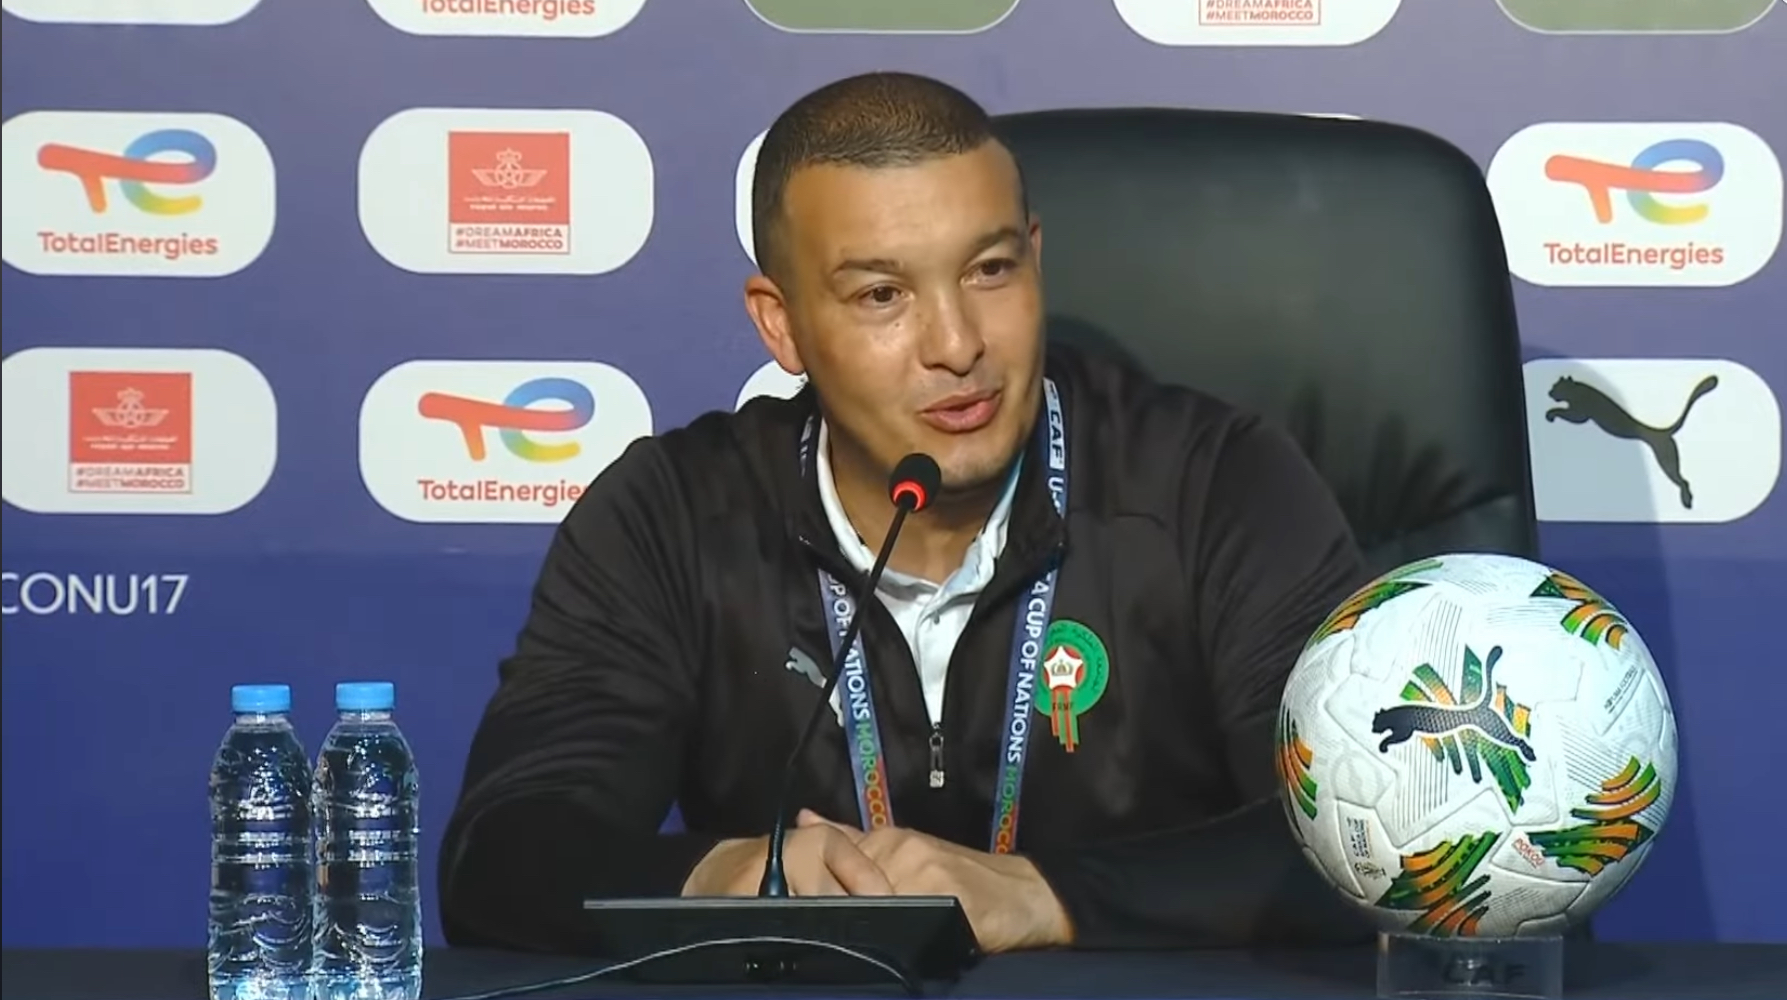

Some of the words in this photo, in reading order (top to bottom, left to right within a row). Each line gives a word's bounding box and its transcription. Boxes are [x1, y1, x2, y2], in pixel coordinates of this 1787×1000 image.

[421, 0, 596, 20] TotalEnergies
[1206, 10, 1313, 20] #MEETMOROCCO
[37, 232, 218, 260] TotalEnergies
[456, 227, 562, 237] #DREAMAFRICA
[456, 239, 563, 249] #MEETMOROCCO
[1543, 242, 1724, 270] TotalEnergies
[1050, 409, 1063, 458] CAF
[418, 480, 588, 507] TotalEnergie
[1026, 597, 1046, 638] CUP
[1020, 640, 1040, 671] OF
[1007, 672, 1034, 763] NATIONS
[856, 722, 887, 828] MOROCCO
